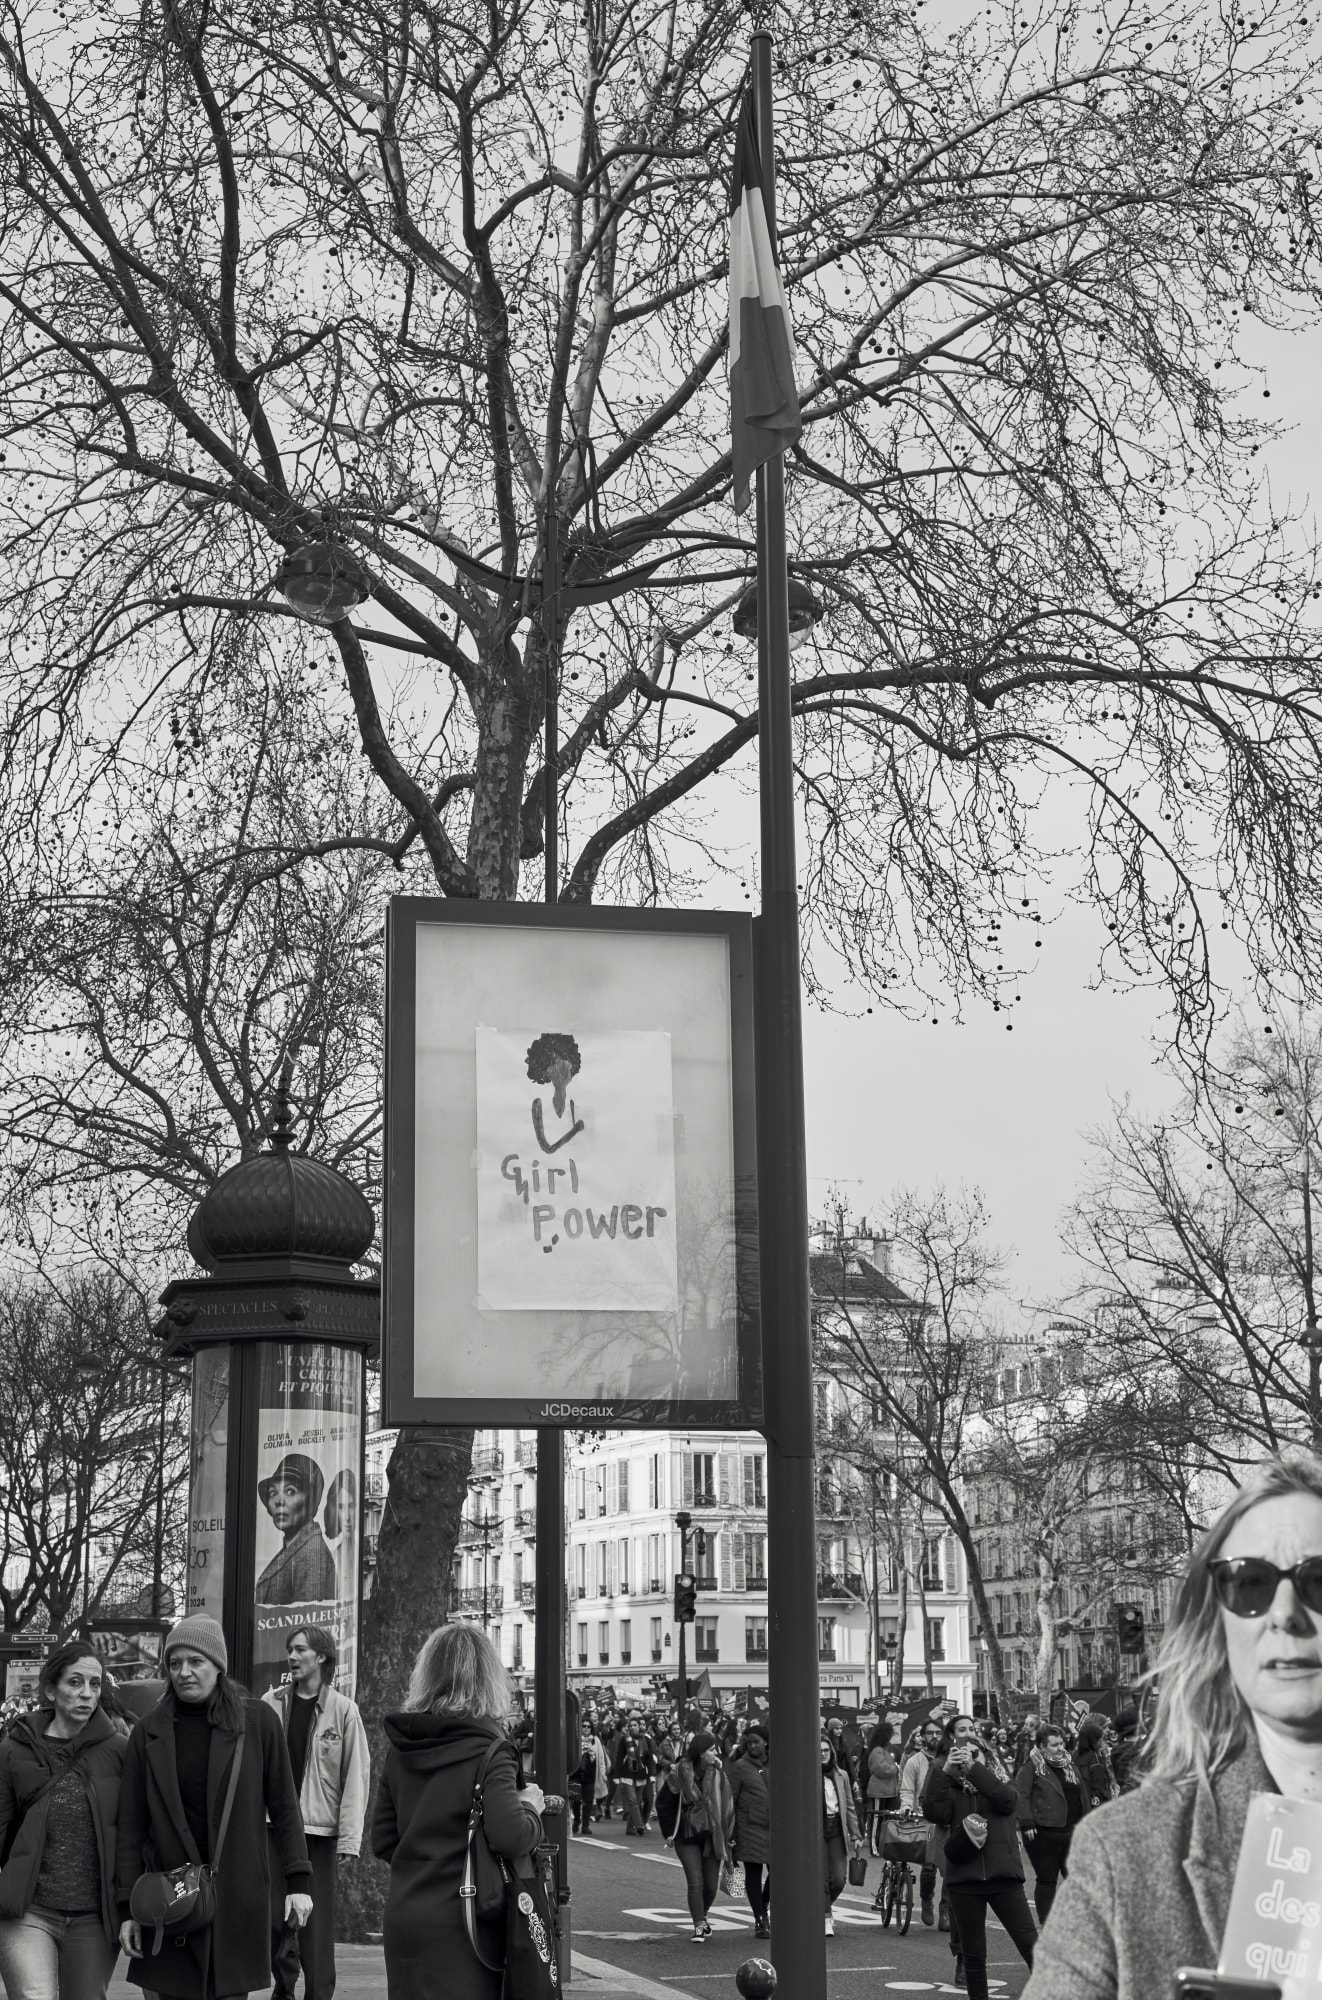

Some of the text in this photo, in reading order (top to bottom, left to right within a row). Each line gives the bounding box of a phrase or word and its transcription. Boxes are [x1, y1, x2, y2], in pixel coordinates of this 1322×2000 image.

[500, 1153, 579, 1203] Girl
[532, 1204, 668, 1242] Power
[199, 1301, 278, 1316] SPECTACLES
[278, 1381, 298, 1392] ET
[540, 1403, 615, 1417] JCDecaux
[267, 1432, 290, 1442] OLIVIA
[302, 1428, 324, 1438] JESSIE
[263, 1439, 293, 1450] COLMAN
[298, 1436, 326, 1446] BUCKLEY
[192, 1518, 226, 1533] SOLEIL
[828, 1674, 845, 1683] Paris
[1265, 1826, 1312, 1875] La
[1245, 1939, 1312, 1982] qui
